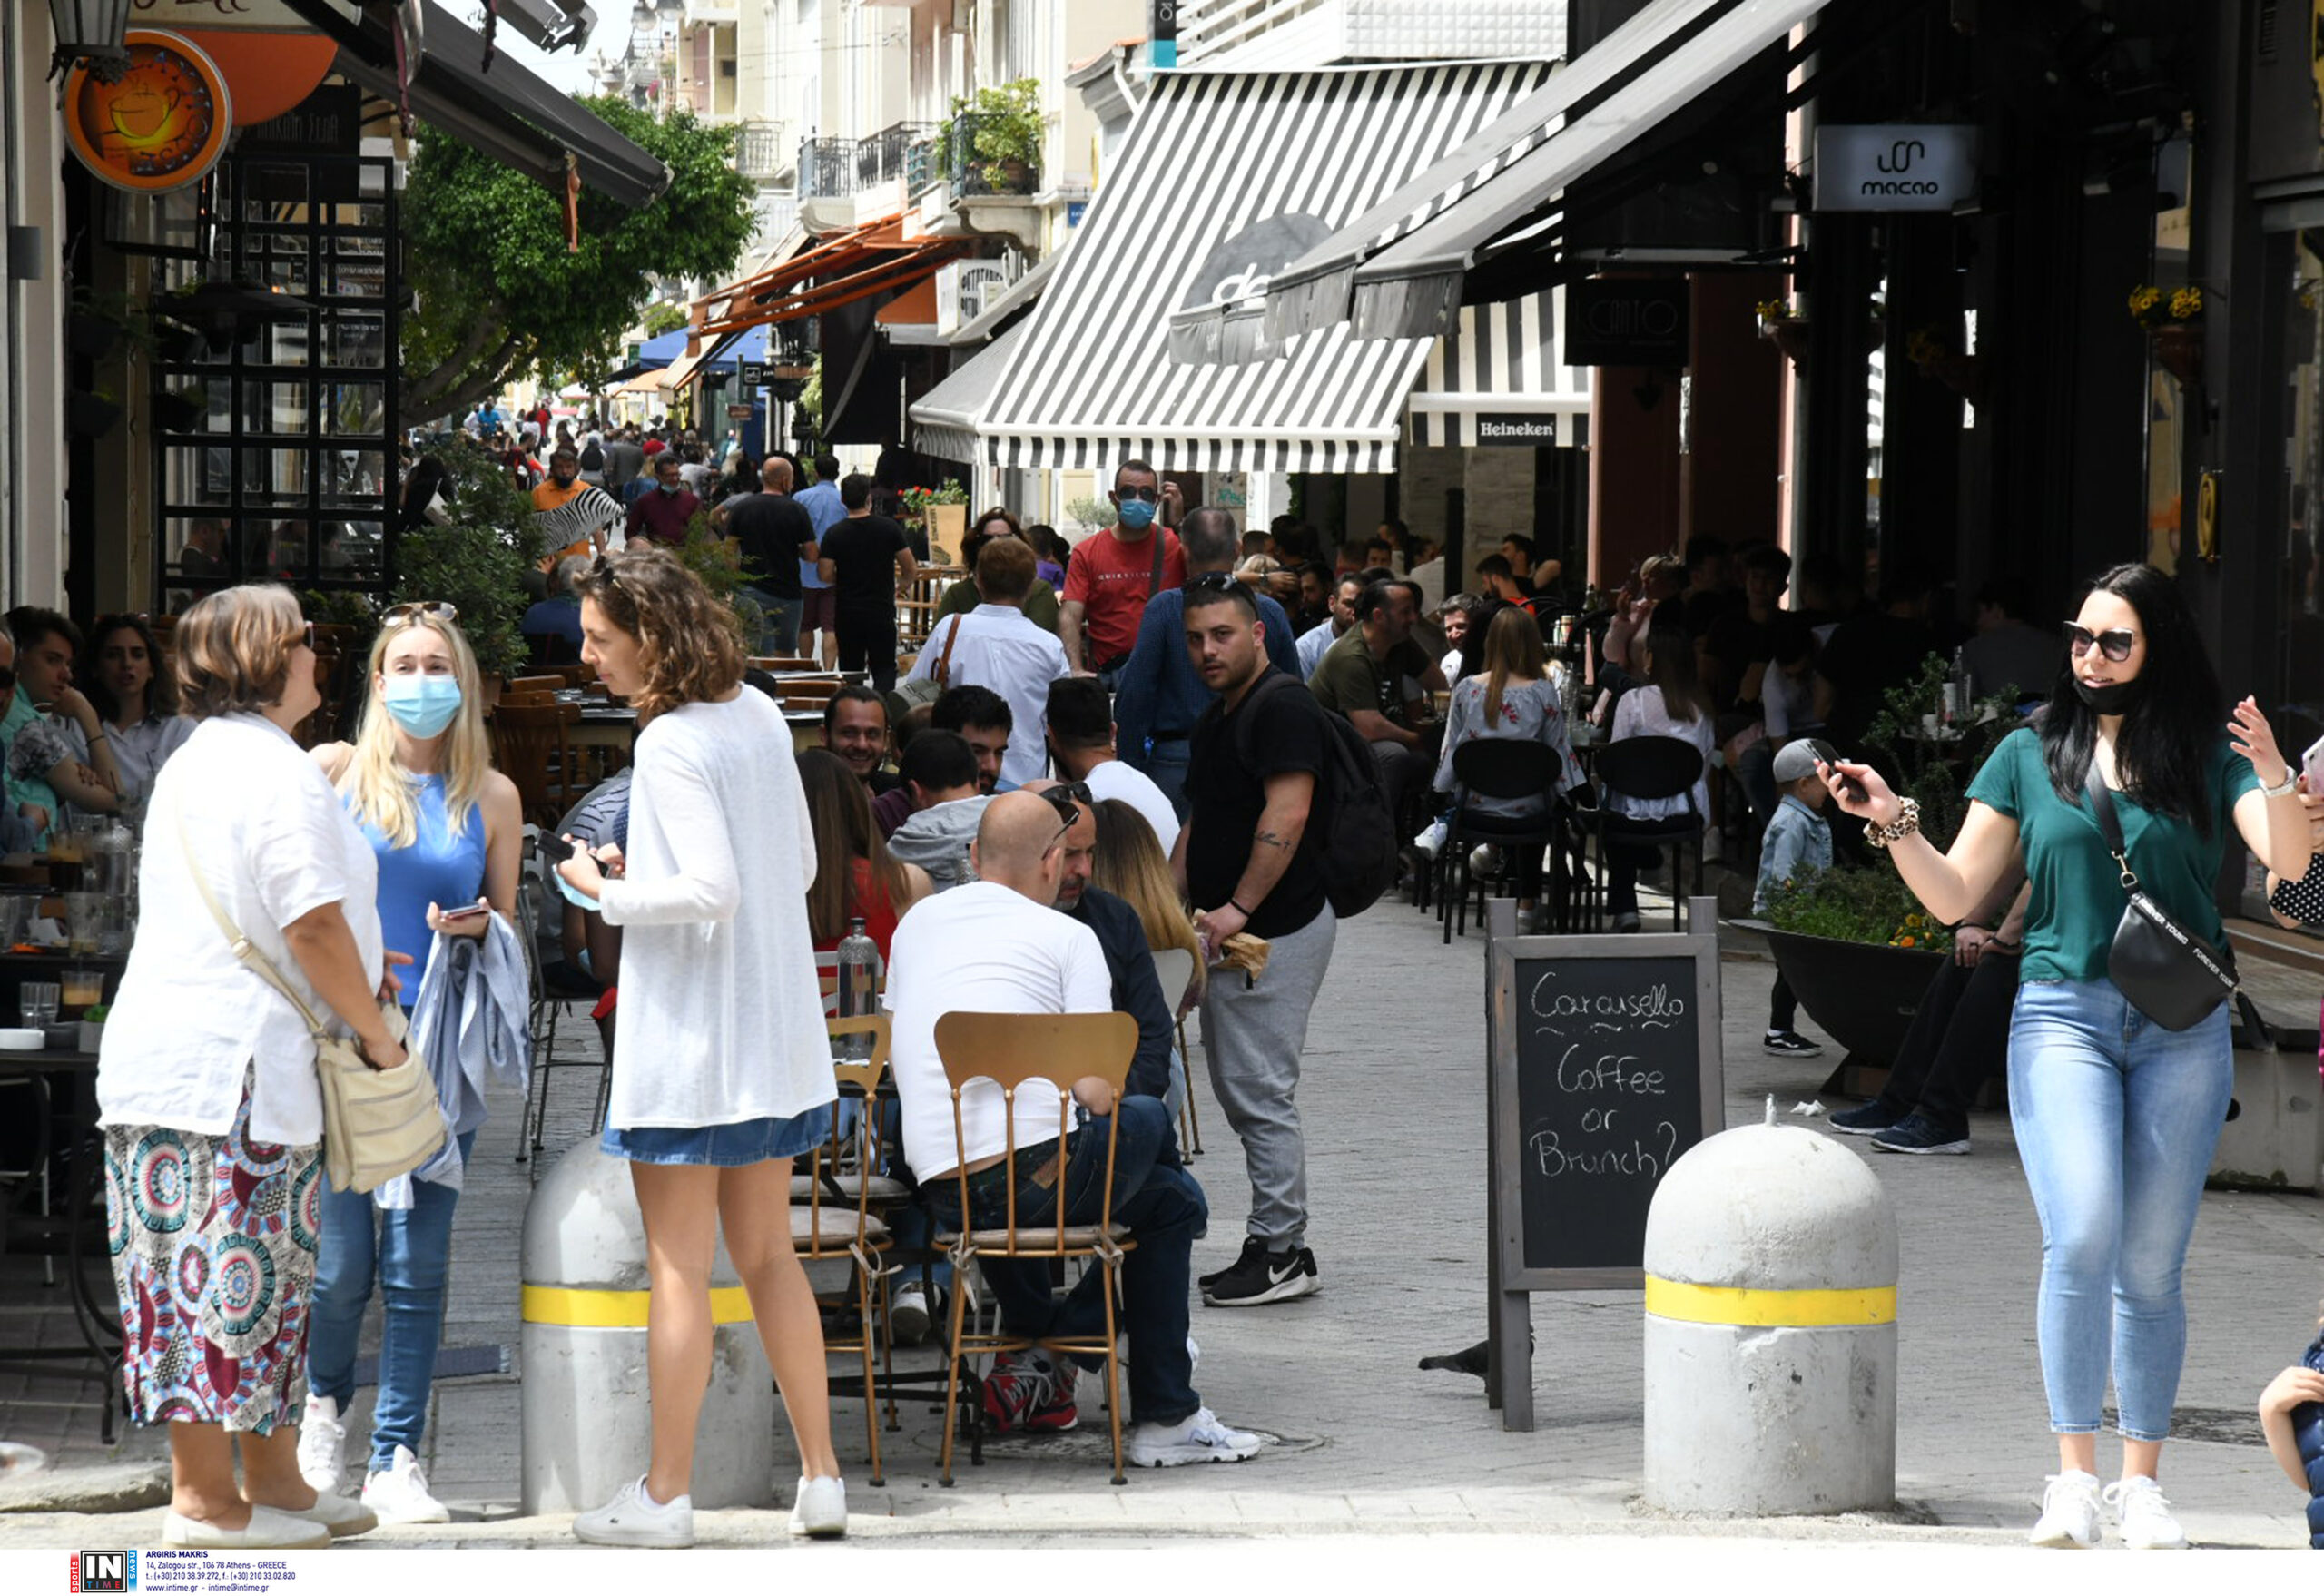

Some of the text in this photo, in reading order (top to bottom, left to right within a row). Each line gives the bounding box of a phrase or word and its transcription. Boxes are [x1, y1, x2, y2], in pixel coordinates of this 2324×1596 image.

[1861, 182, 1939, 195] macao
[1480, 422, 1554, 437] Heineken
[1581, 1108, 1619, 1133] or
[1529, 1121, 1678, 1178] Brunch?
